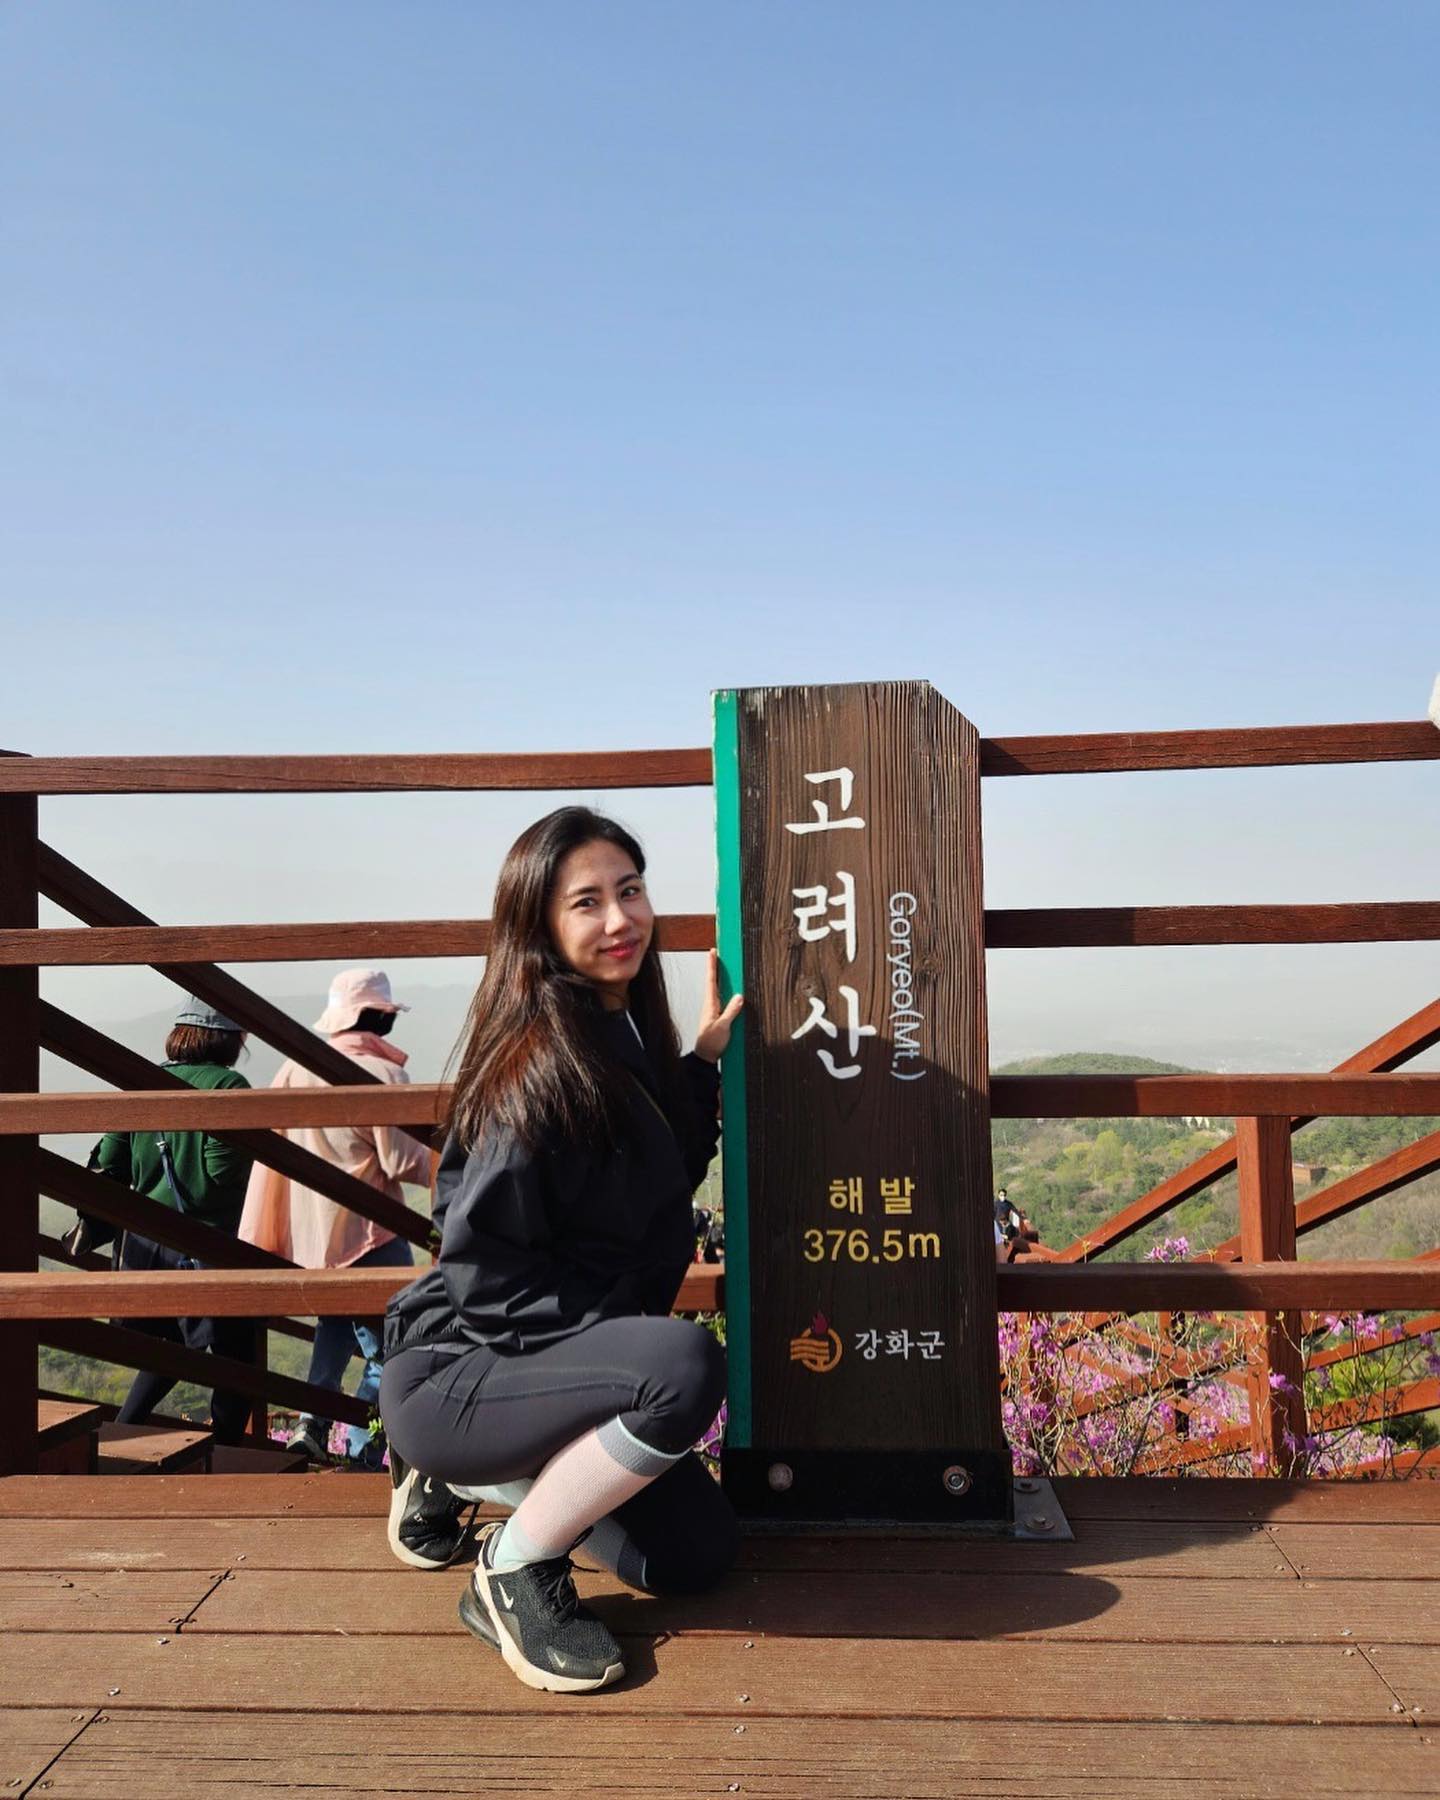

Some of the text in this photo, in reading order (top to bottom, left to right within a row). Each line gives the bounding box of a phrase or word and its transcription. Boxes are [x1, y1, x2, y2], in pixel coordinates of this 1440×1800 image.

[784, 766, 878, 1081] 고려산
[888, 891, 926, 1082] Goryeo(Mt.)
[803, 1229, 941, 1264] 376.5m
[854, 1329, 945, 1360] 강화군
